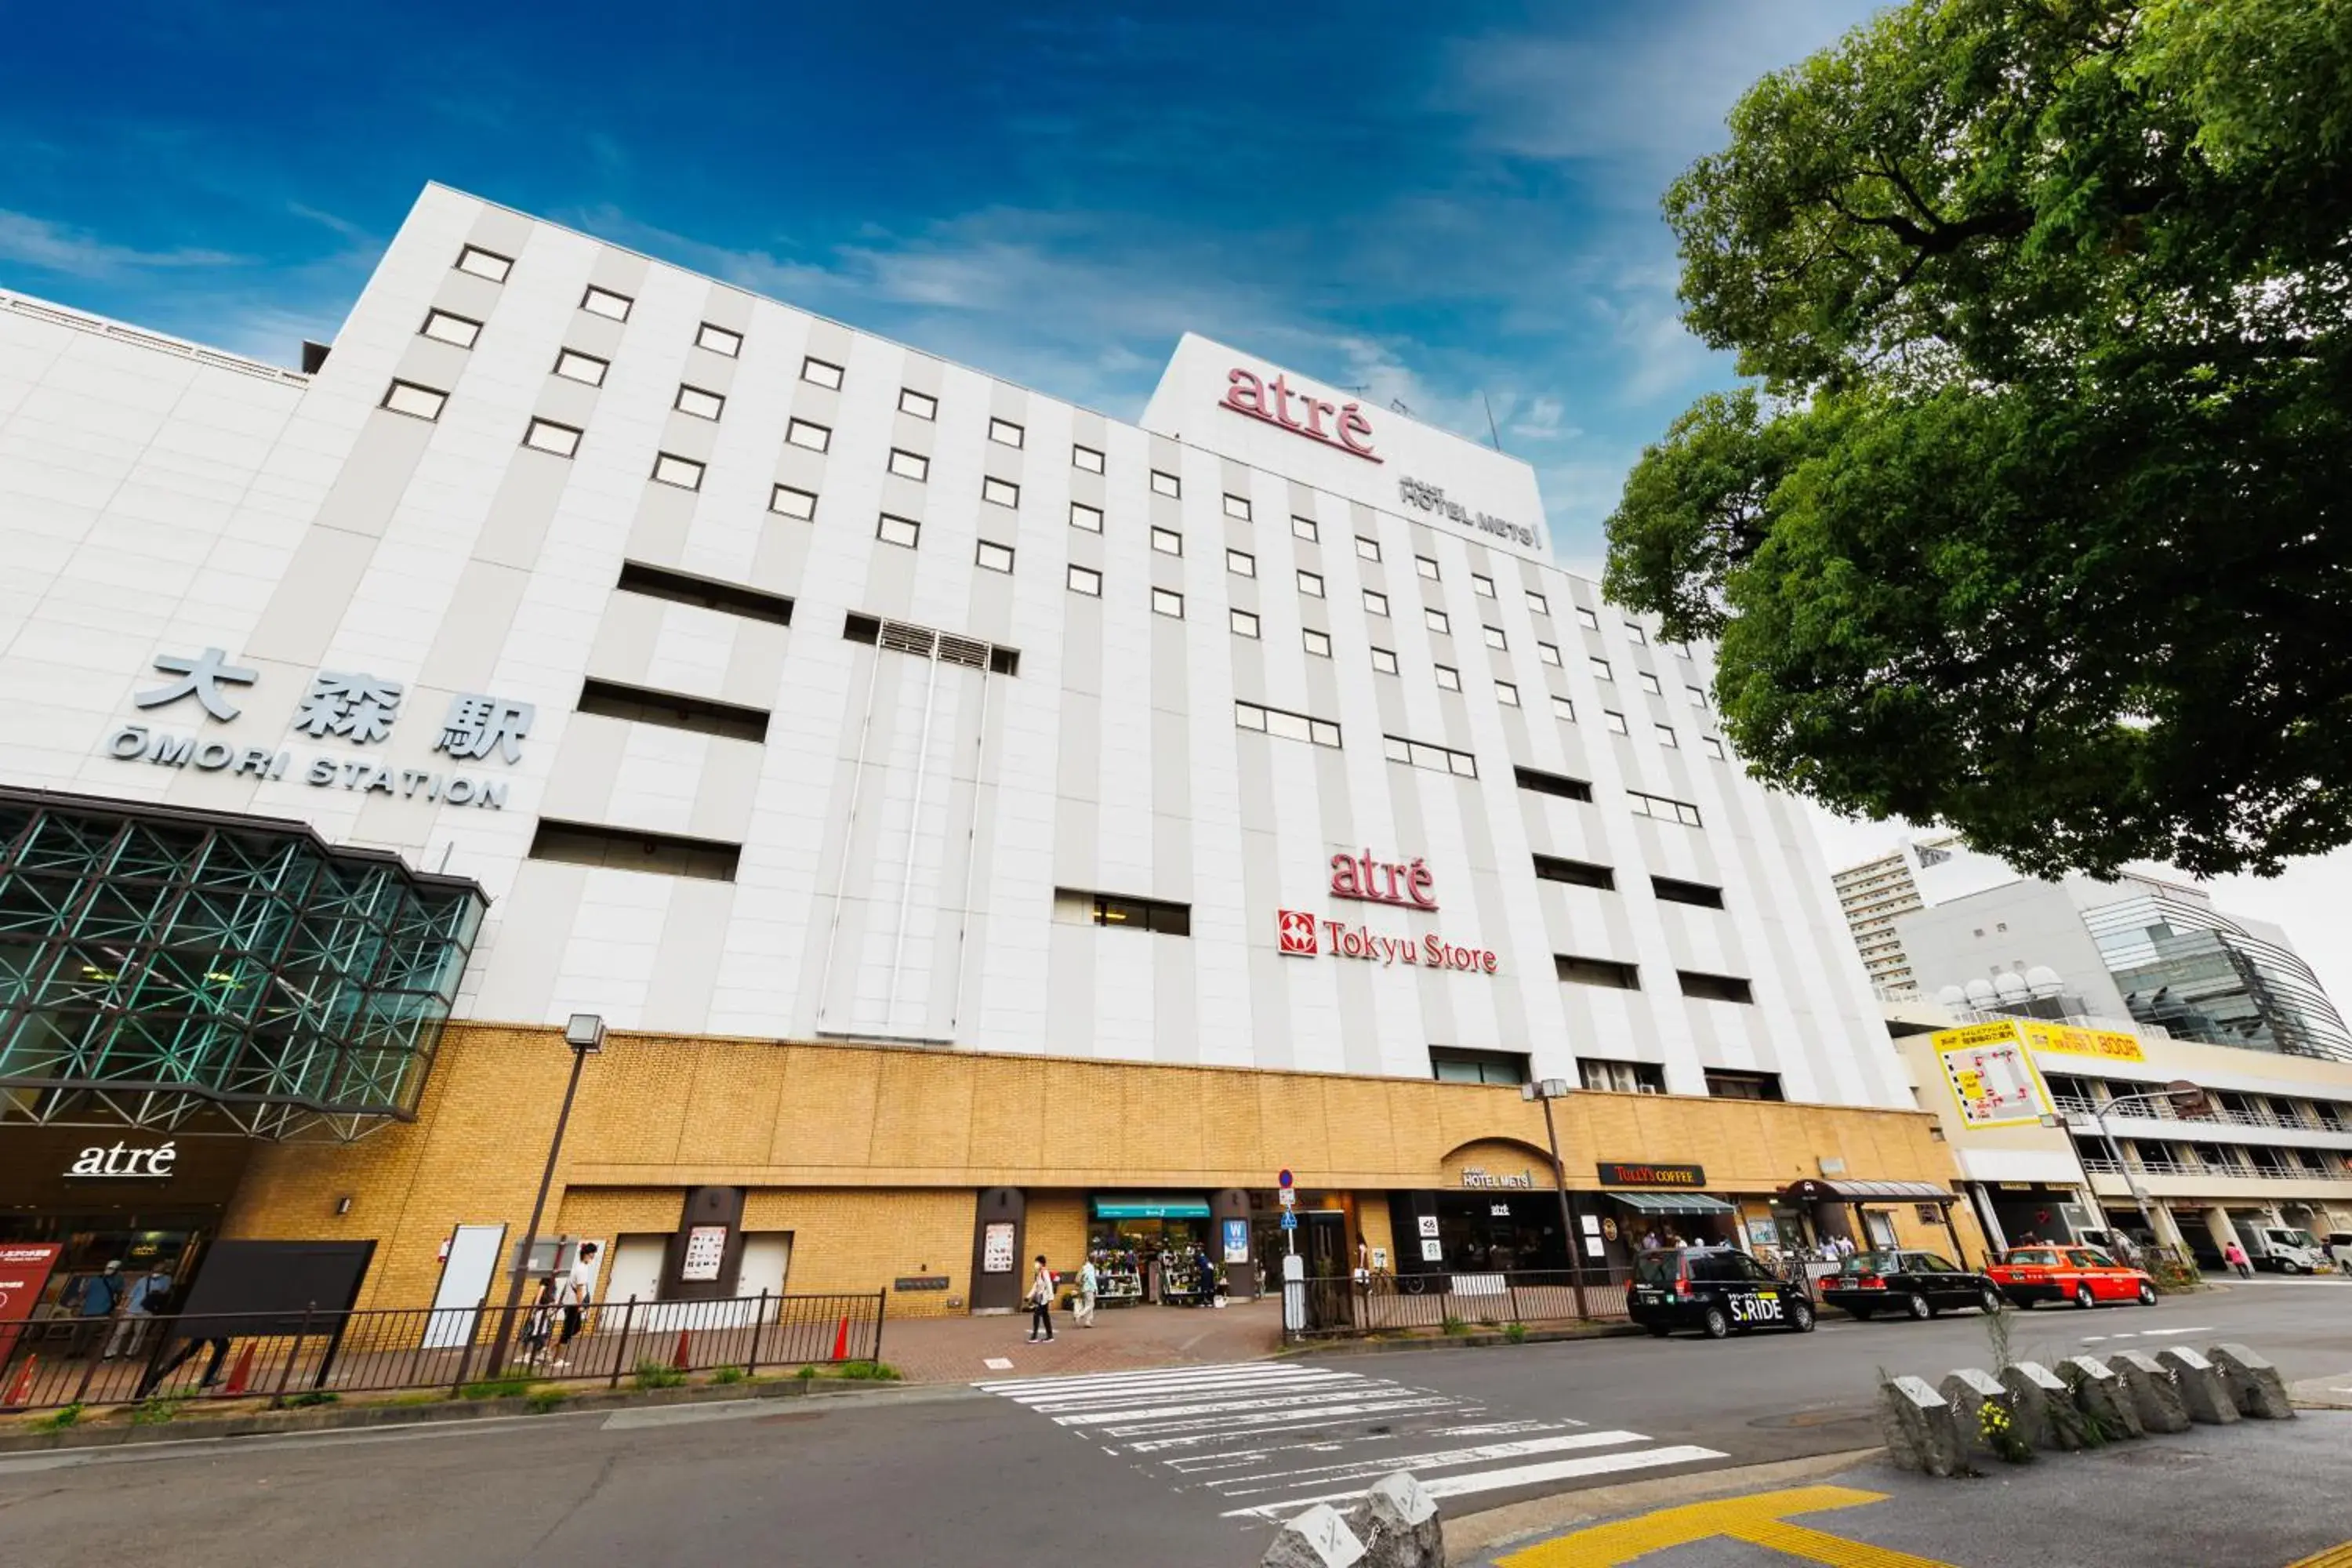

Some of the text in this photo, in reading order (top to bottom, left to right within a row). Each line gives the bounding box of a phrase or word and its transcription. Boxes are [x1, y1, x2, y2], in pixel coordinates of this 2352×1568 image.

[1220, 367, 1383, 463] atré
[1399, 482, 1474, 527] HOTEL
[1475, 511, 1534, 547] METS
[133, 647, 535, 764] 大森駅
[306, 757, 509, 809] STATION
[1330, 848, 1439, 912] atré
[1323, 920, 1499, 974] Tokyu Store
[64, 1141, 176, 1176] atré
[1463, 1174, 1530, 1189] HOTEL METS
[1655, 1171, 1694, 1183] COFFEE
[1730, 1298, 1784, 1322] S.RIDE
